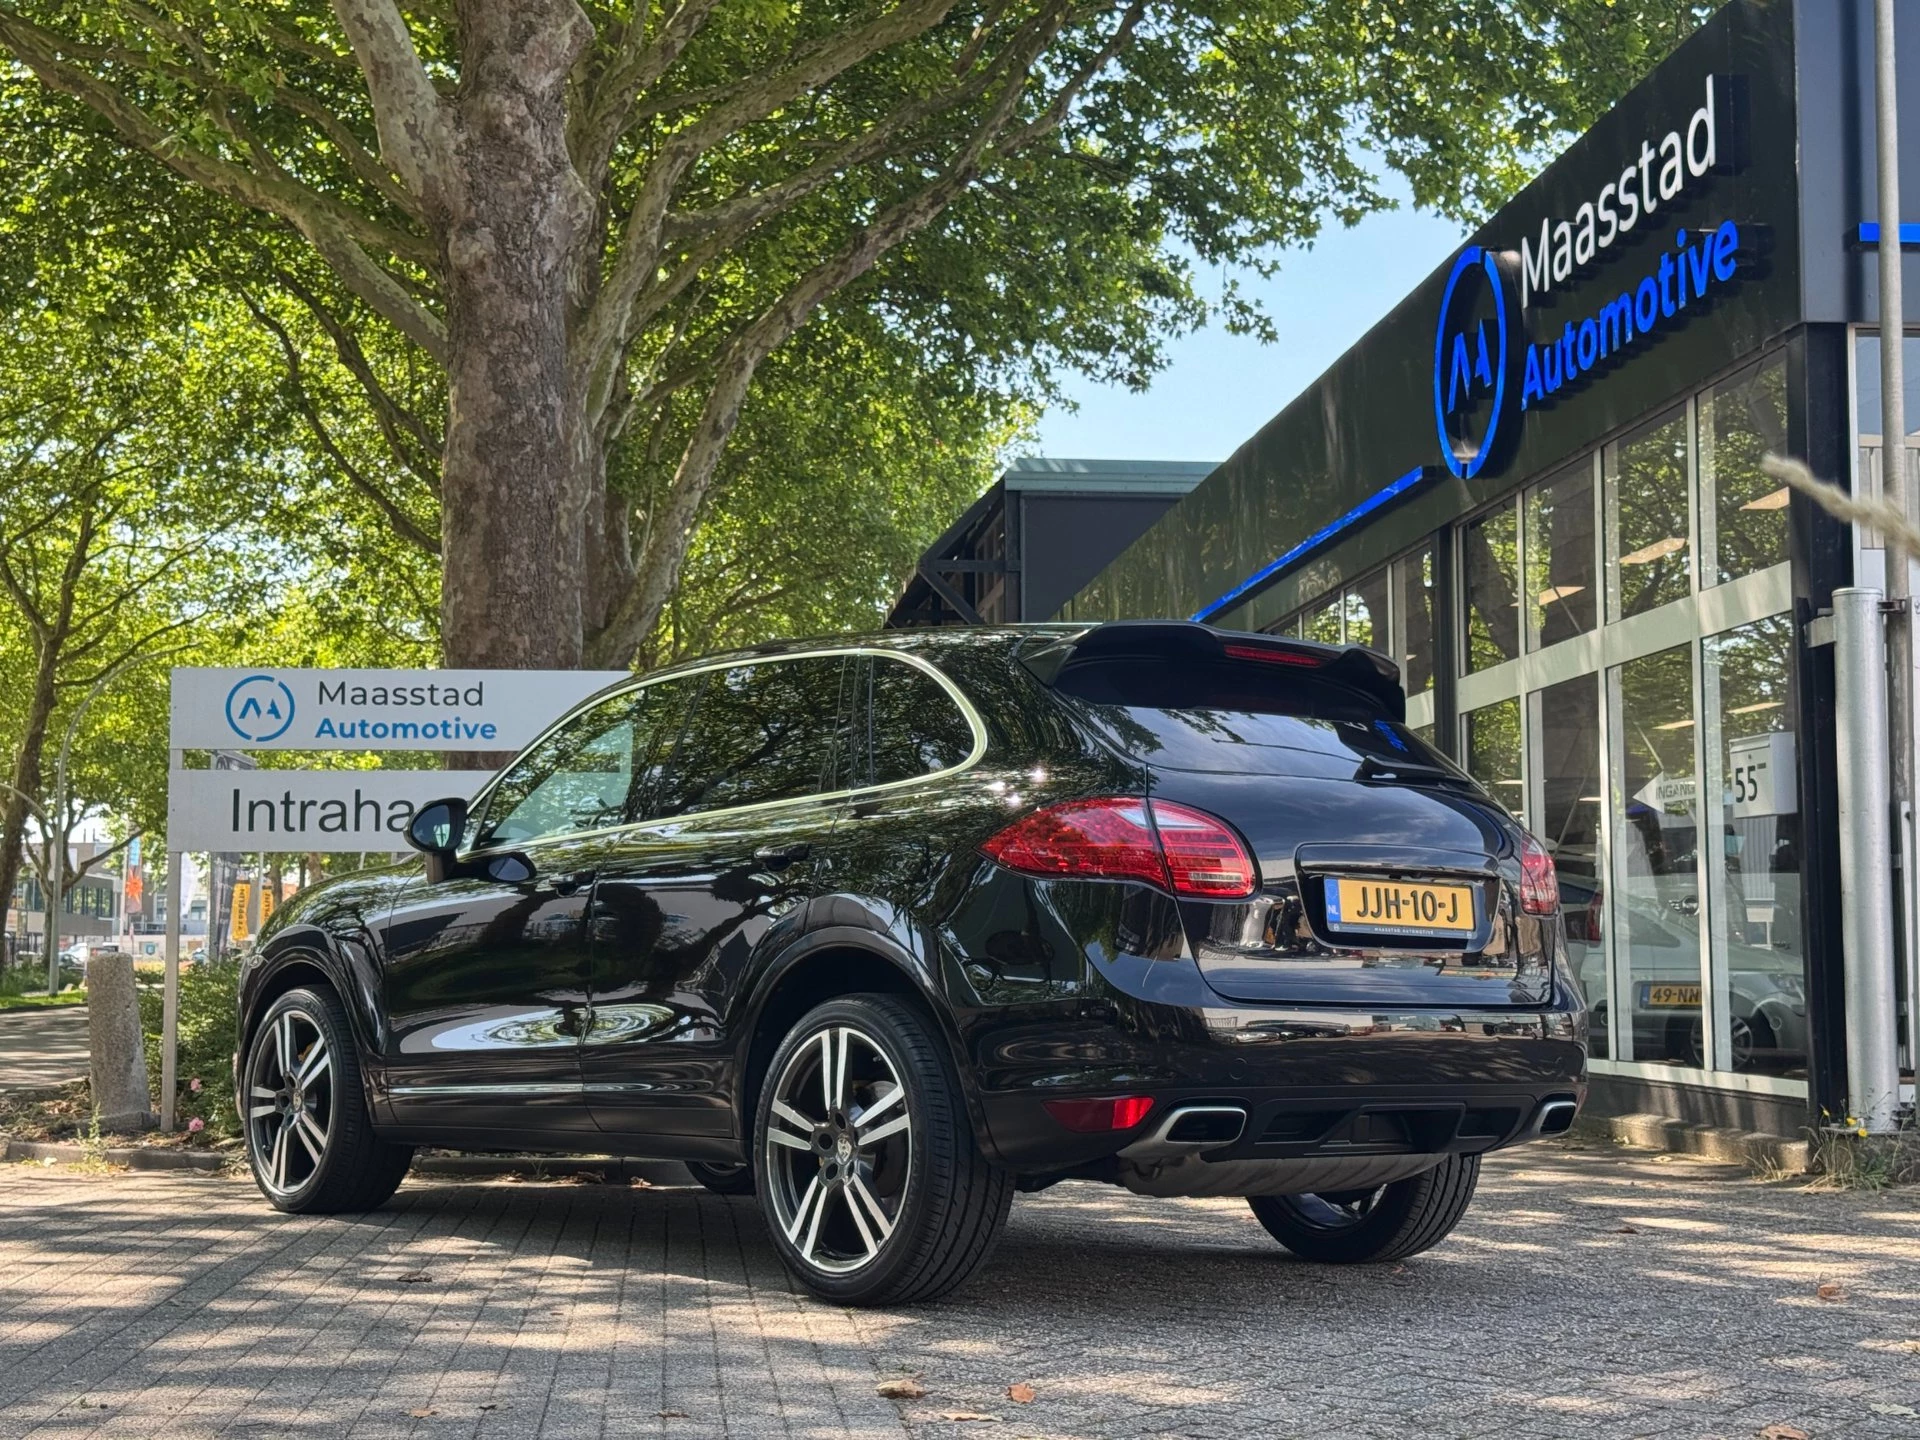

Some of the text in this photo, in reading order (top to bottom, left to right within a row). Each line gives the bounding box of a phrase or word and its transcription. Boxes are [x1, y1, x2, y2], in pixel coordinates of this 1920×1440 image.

[1520, 73, 1717, 309] Maasstad
[1520, 219, 1740, 412] Automotive
[317, 680, 484, 707] Maasstad
[314, 716, 498, 740] Automotive
[231, 787, 415, 833] Intraha
[1327, 904, 1339, 916] NL
[1356, 886, 1459, 923] JJH-10-J
